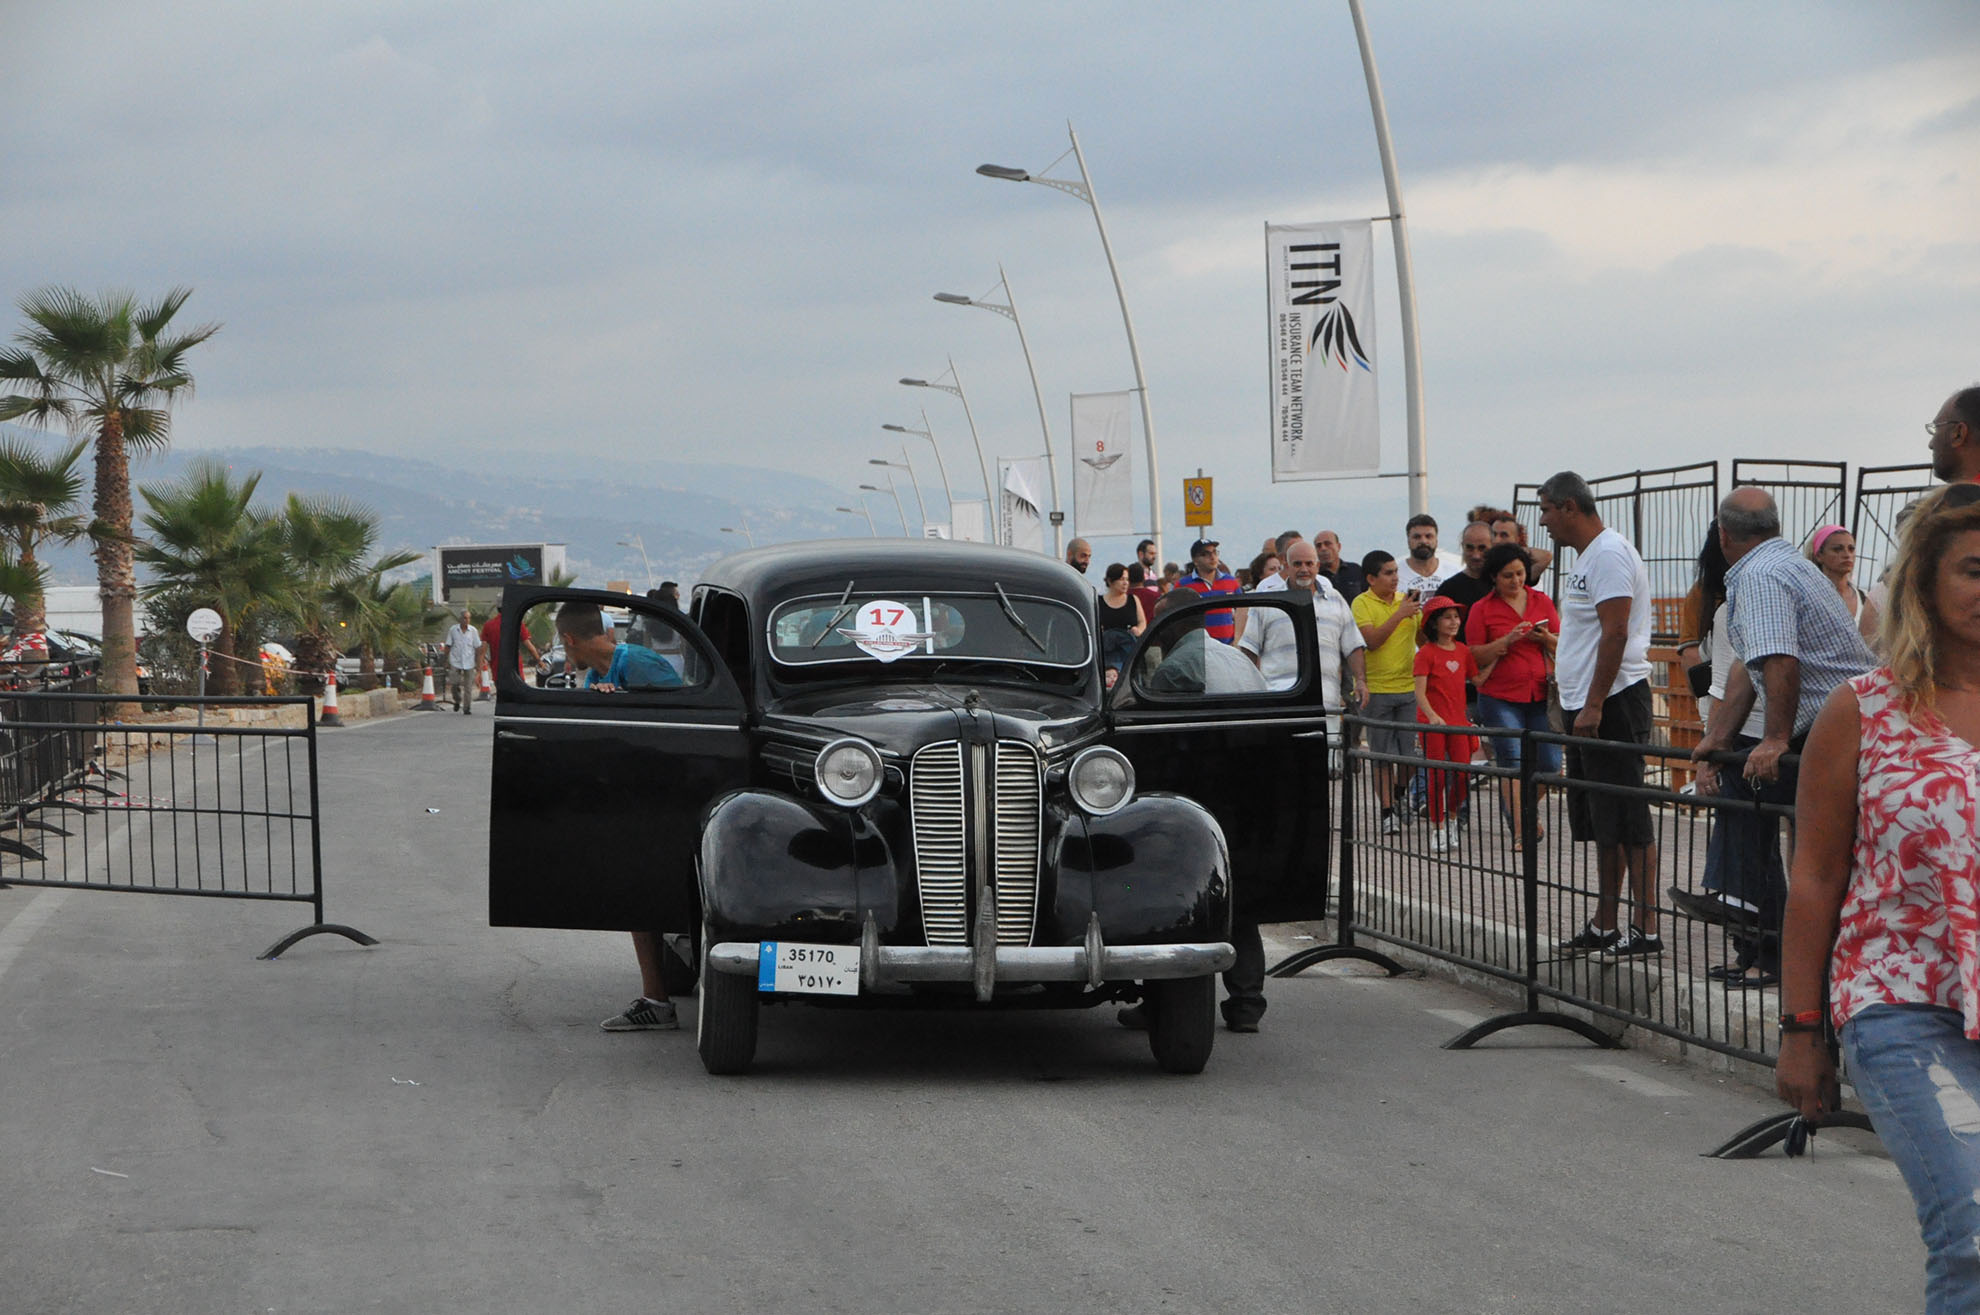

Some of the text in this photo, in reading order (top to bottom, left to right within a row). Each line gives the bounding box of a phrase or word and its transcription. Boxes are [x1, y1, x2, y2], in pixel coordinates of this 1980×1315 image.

[1289, 243, 1342, 306] ITN
[1289, 312, 1303, 365] INSURANCE
[1290, 368, 1303, 394] TEAM
[1290, 395, 1304, 442] NETWORK
[1096, 440, 1104, 453] 8
[870, 608, 904, 626] 17
[789, 948, 834, 963] 35170
[797, 974, 842, 989] ٣٥١٧٠
